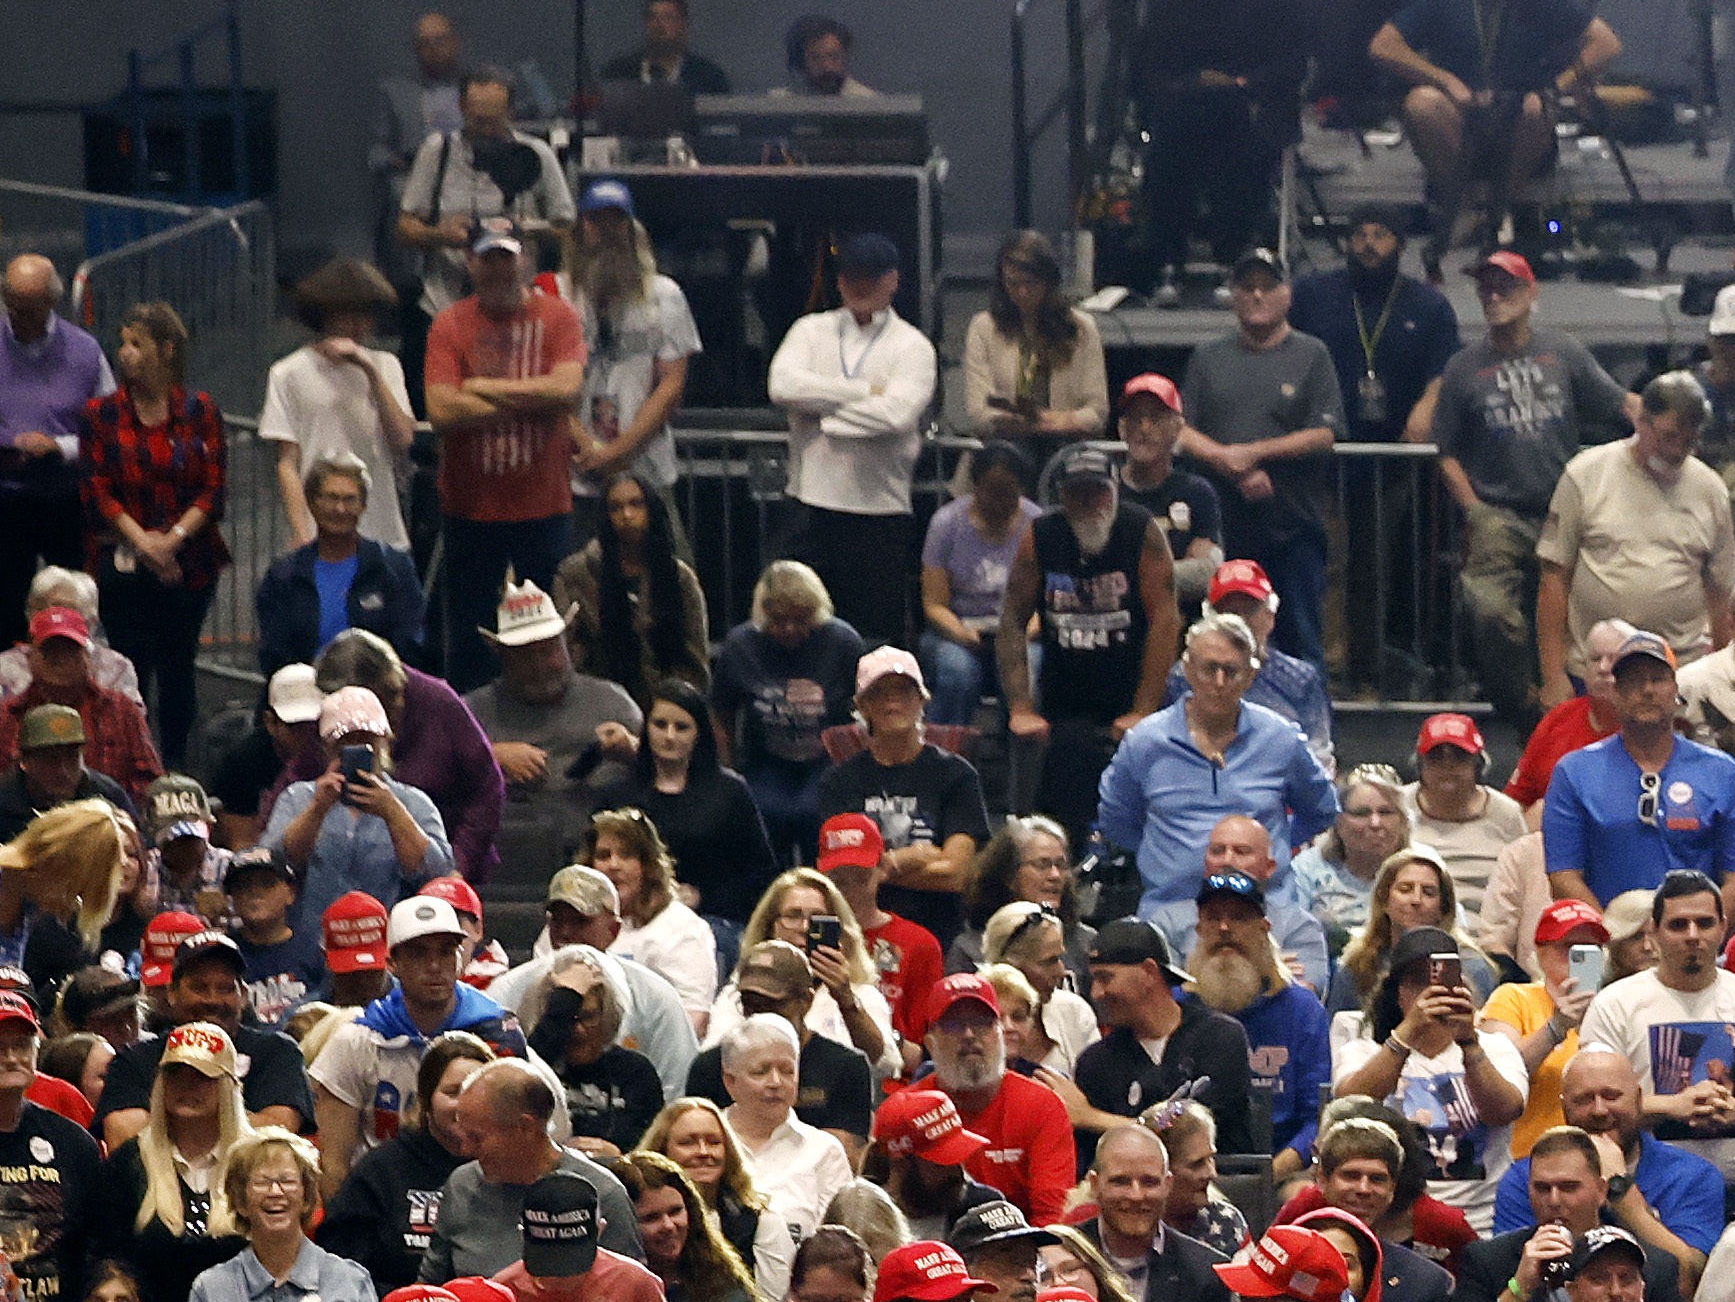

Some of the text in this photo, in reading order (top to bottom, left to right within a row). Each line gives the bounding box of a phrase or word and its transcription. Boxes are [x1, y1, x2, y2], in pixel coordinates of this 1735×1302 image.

[30, 1166, 61, 1185] FOR
[914, 1252, 944, 1270] MAKE
[926, 1263, 951, 1280] GREAT
